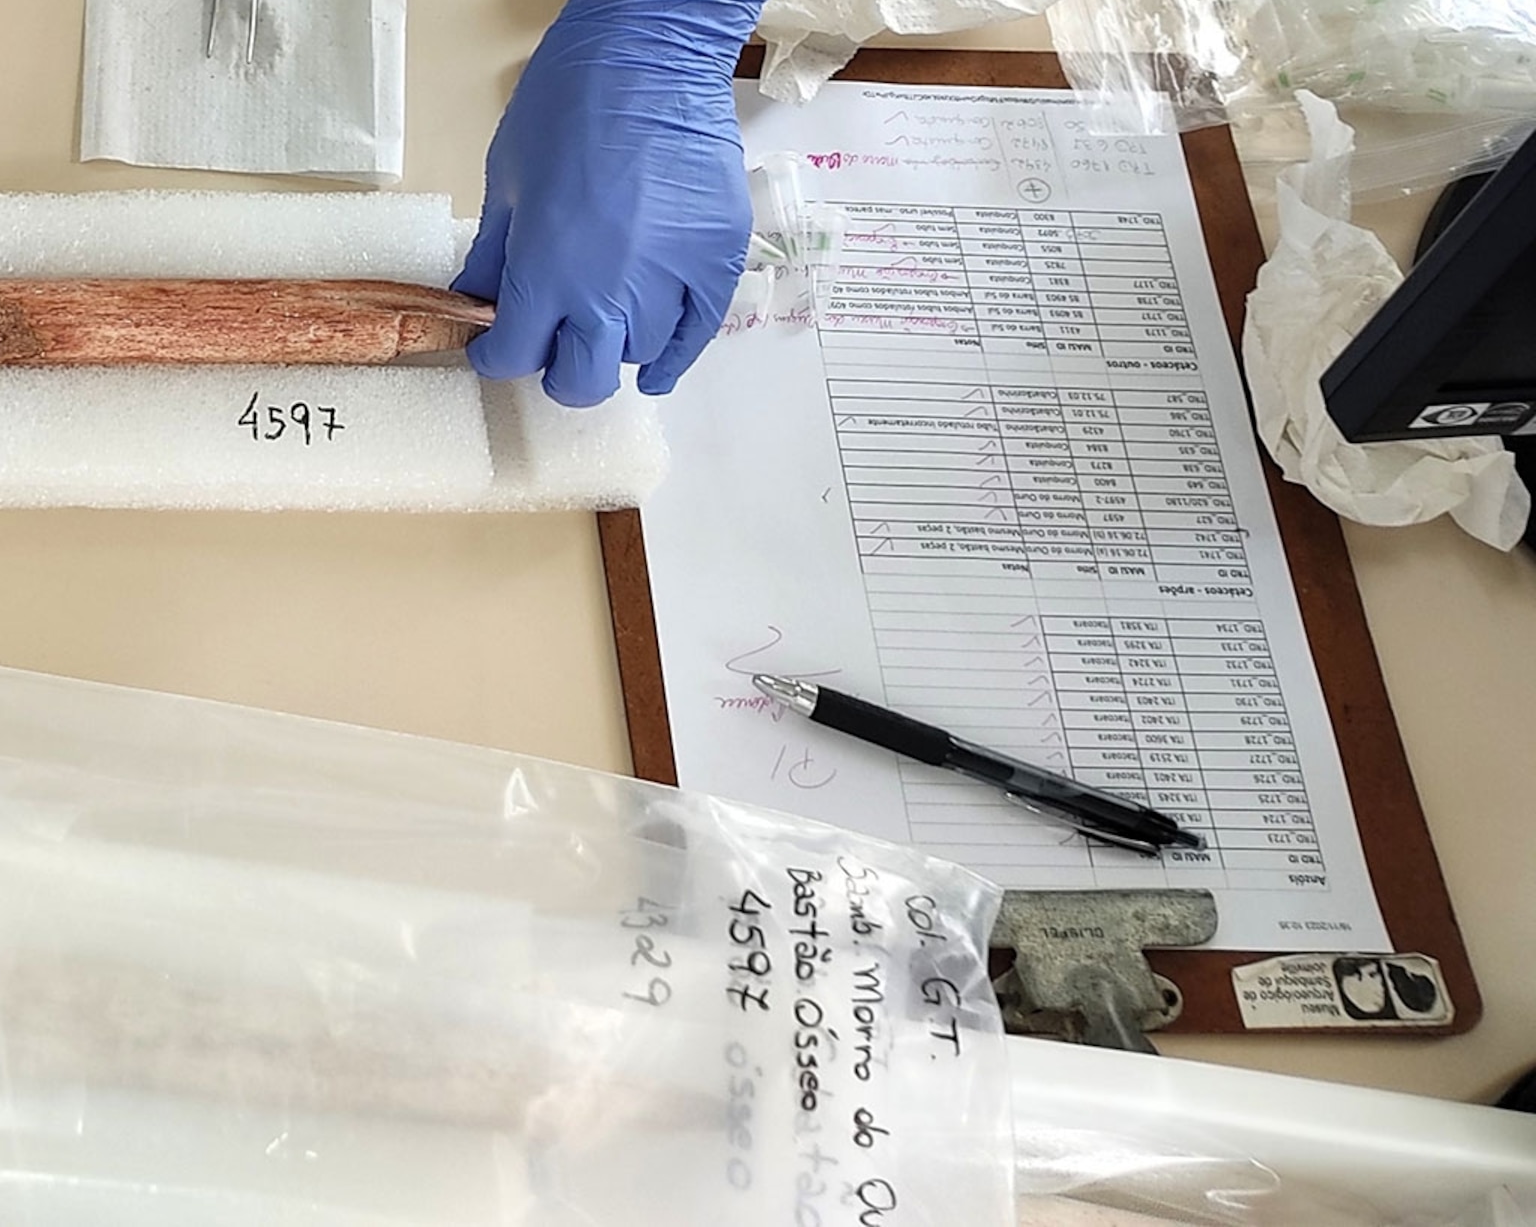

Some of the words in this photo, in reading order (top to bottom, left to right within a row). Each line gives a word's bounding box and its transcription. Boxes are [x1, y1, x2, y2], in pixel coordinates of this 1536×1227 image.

[1106, 360, 1141, 369] outros
[1150, 361, 1198, 371] Cetáceos
[236, 390, 346, 445] 4597
[1158, 584, 1194, 596] arpões
[1204, 586, 1253, 598] Cetáceos
[787, 865, 832, 982] Bastão
[903, 893, 948, 949] Col.
[725, 887, 772, 1012] 4597
[1257, 976, 1272, 988] de
[1274, 974, 1332, 988] Sambaqui
[1243, 990, 1257, 1002] de
[1260, 987, 1334, 1002] Arqueológico
[920, 975, 964, 1061] G.T.
[1301, 1004, 1340, 1017] Museu
[852, 962, 885, 1081] Morro
[852, 1106, 891, 1149] do
[855, 1177, 898, 1227] Ou
